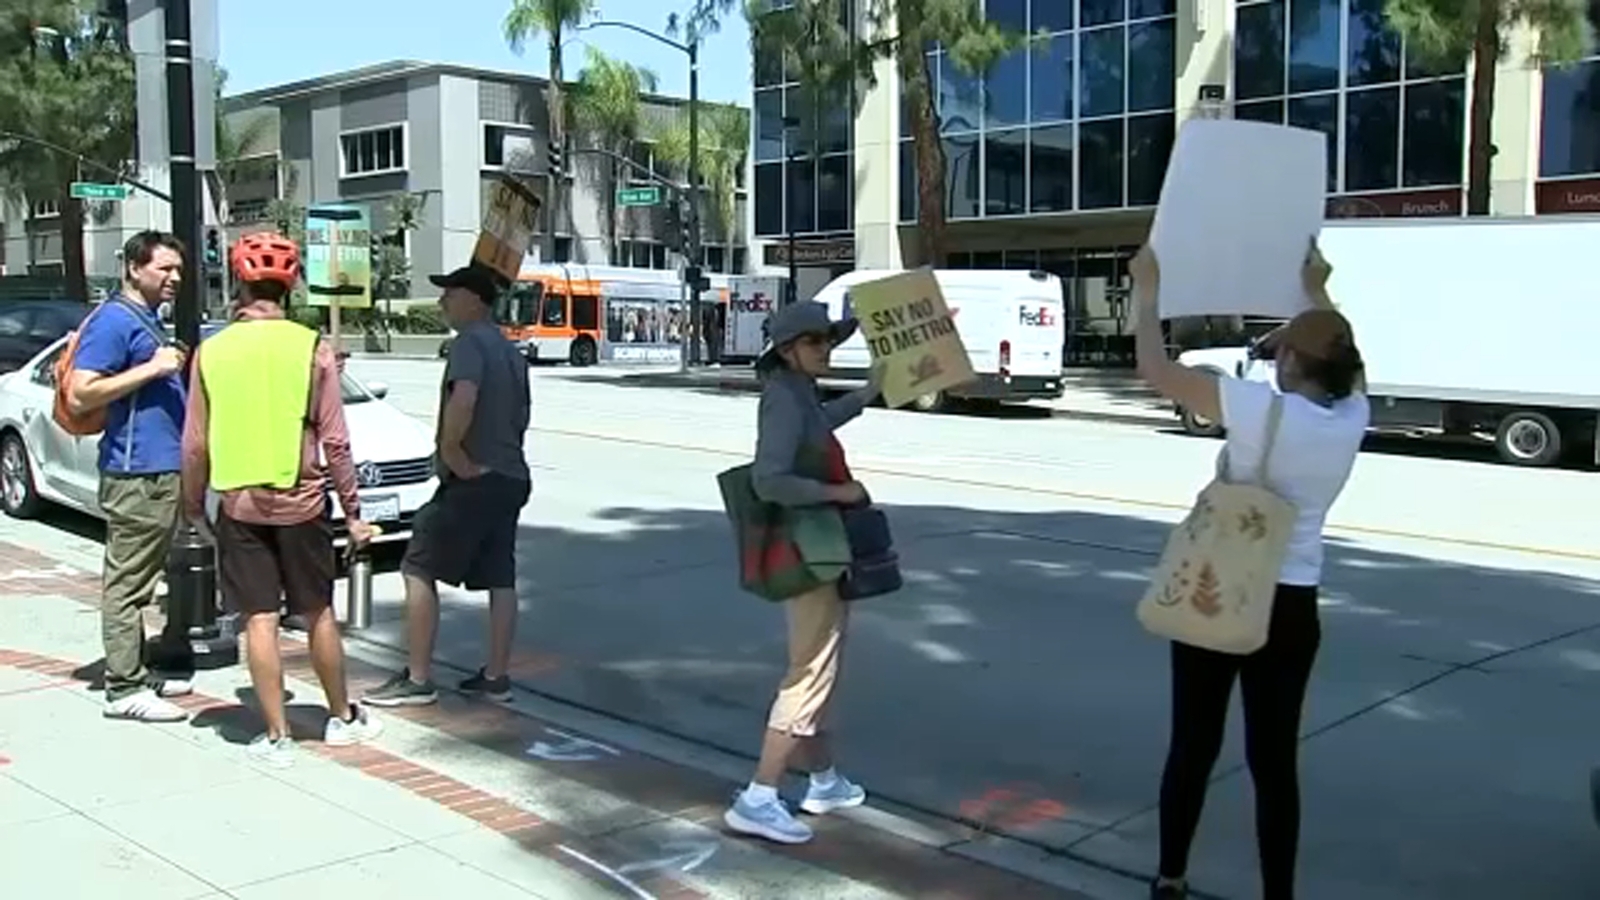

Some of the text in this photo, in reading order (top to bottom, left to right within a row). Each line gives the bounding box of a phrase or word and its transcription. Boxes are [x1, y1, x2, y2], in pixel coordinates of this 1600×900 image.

[1402, 200, 1450, 215] Brunch
[731, 292, 771, 312] FedEx
[870, 298, 934, 332] SAY NO
[1019, 304, 1055, 326] FedEx
[867, 316, 955, 358] TO METRO
